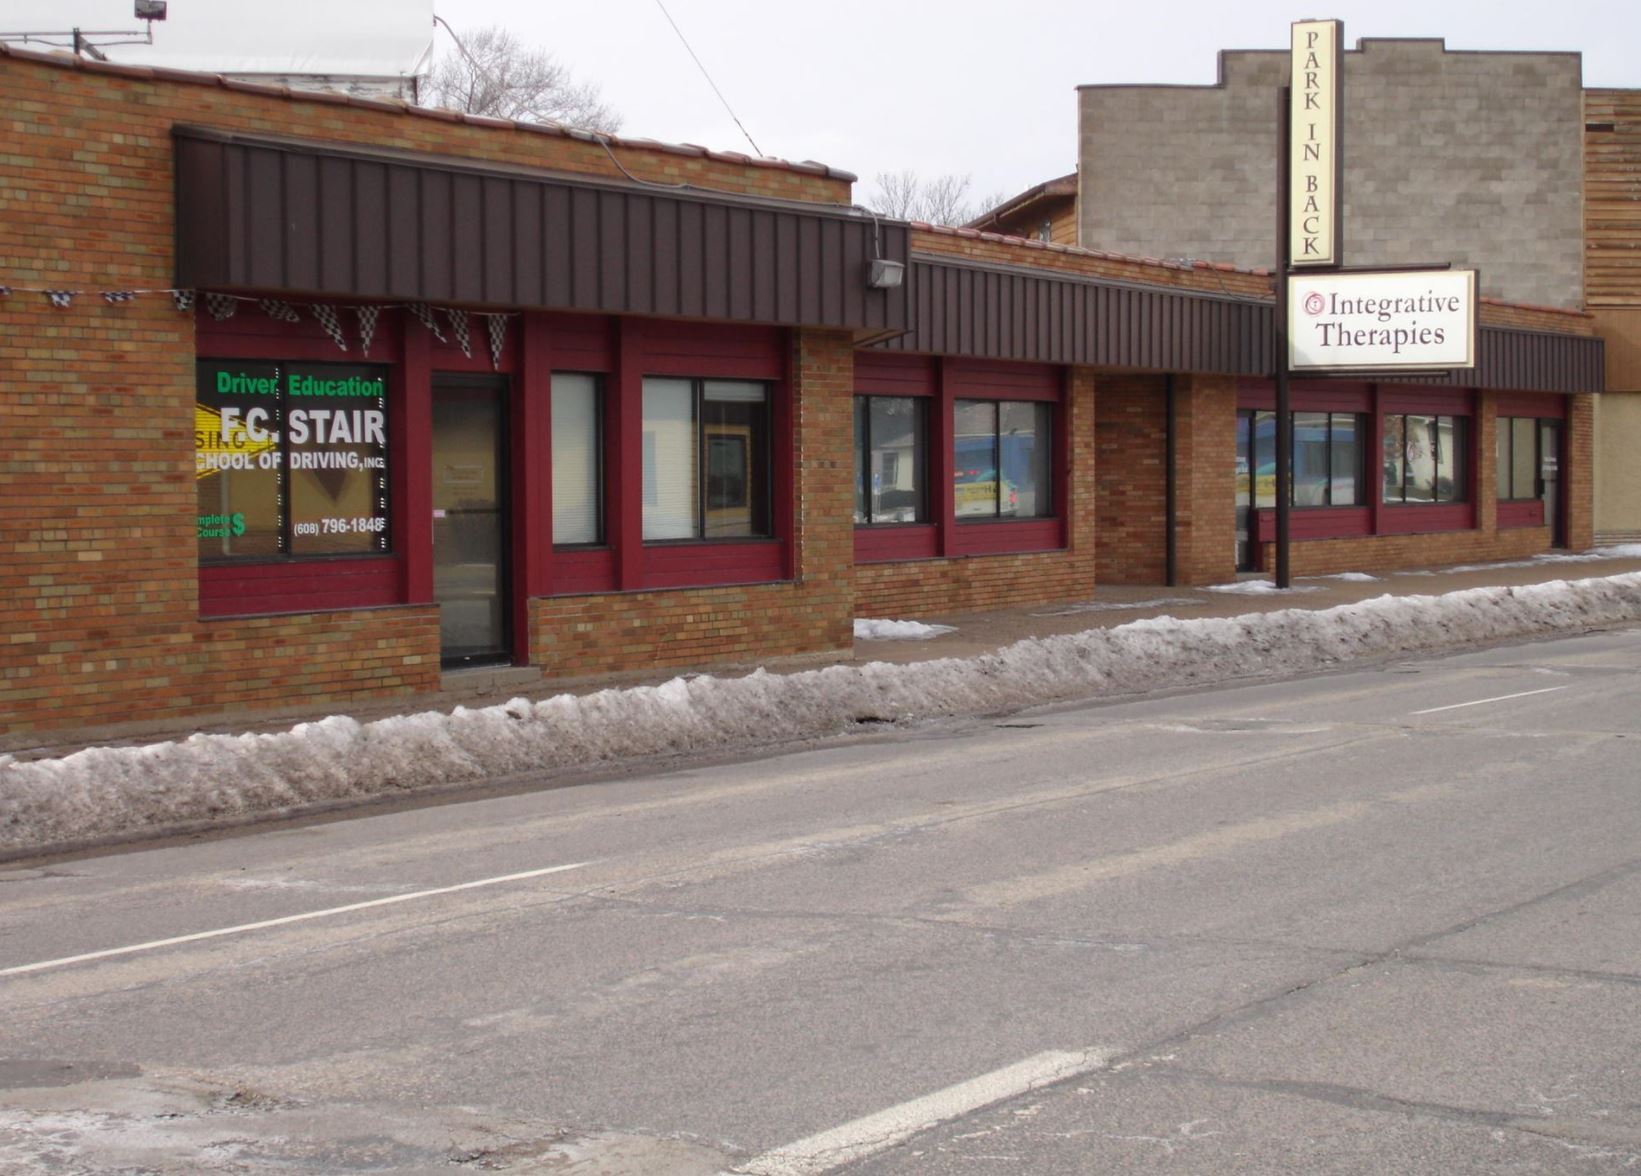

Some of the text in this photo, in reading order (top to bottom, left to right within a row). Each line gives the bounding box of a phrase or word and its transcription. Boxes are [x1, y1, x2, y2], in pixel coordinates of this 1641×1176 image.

[1303, 31, 1321, 255] PARK IN BACK
[1329, 290, 1460, 321] Integrative
[1316, 320, 1445, 353] Therapies
[217, 371, 383, 397] Driver Education
[220, 407, 386, 444] F.C. STAIR
[259, 451, 282, 469] OF
[293, 517, 383, 536] (608) 796-1848
